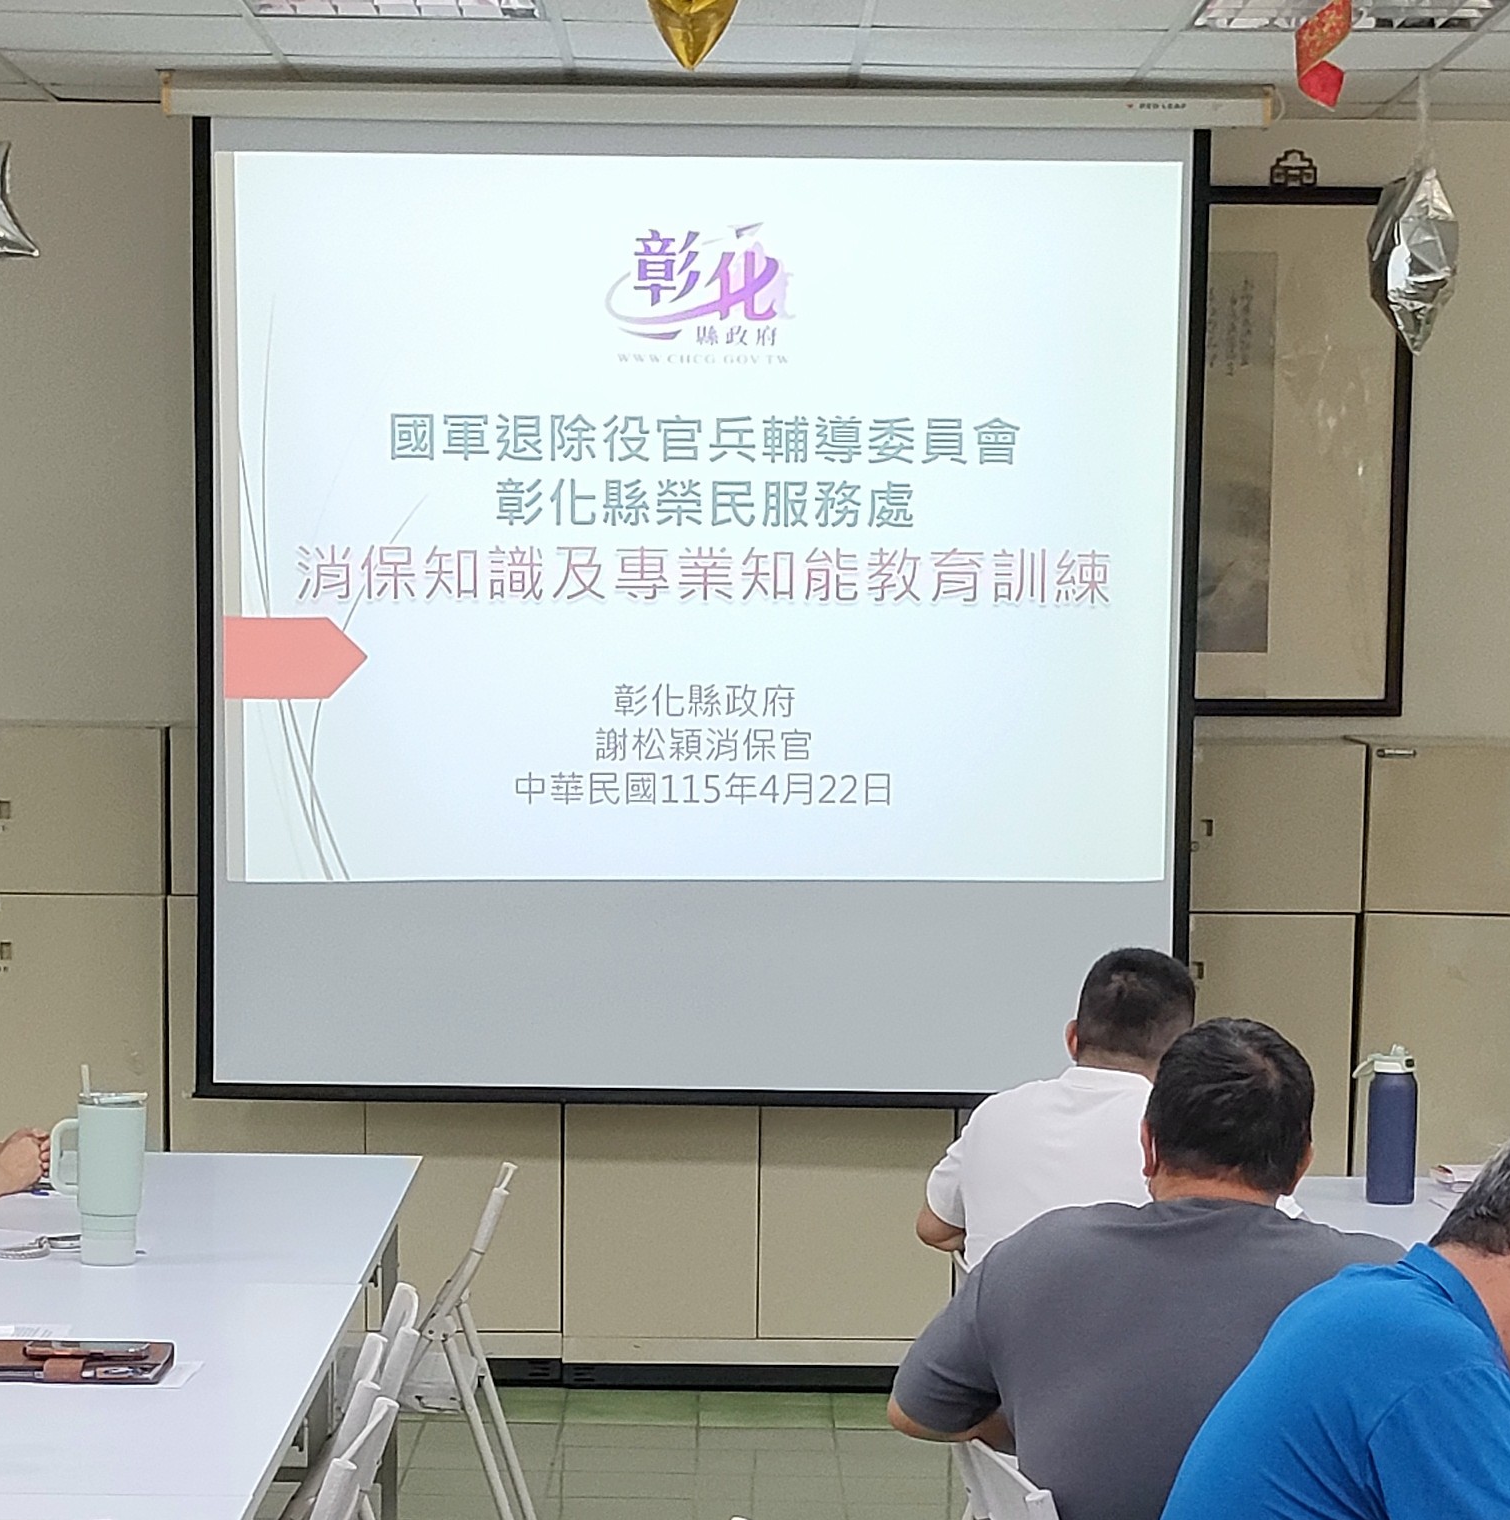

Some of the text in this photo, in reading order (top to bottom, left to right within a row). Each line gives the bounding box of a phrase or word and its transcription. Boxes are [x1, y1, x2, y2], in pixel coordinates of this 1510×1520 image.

[633, 228, 780, 322] 彰化
[696, 324, 778, 346] 縣政府
[389, 412, 1022, 466] 國軍退除役官兵輔導委員會
[495, 477, 915, 529] 彰化縣榮民服務處
[295, 541, 1112, 607] 消保知識及專業知能教育訓練
[613, 682, 796, 718] 彰化縣政府
[595, 726, 812, 763] 謝松穎消保官
[515, 771, 891, 807] 中華民國115年4月22日
